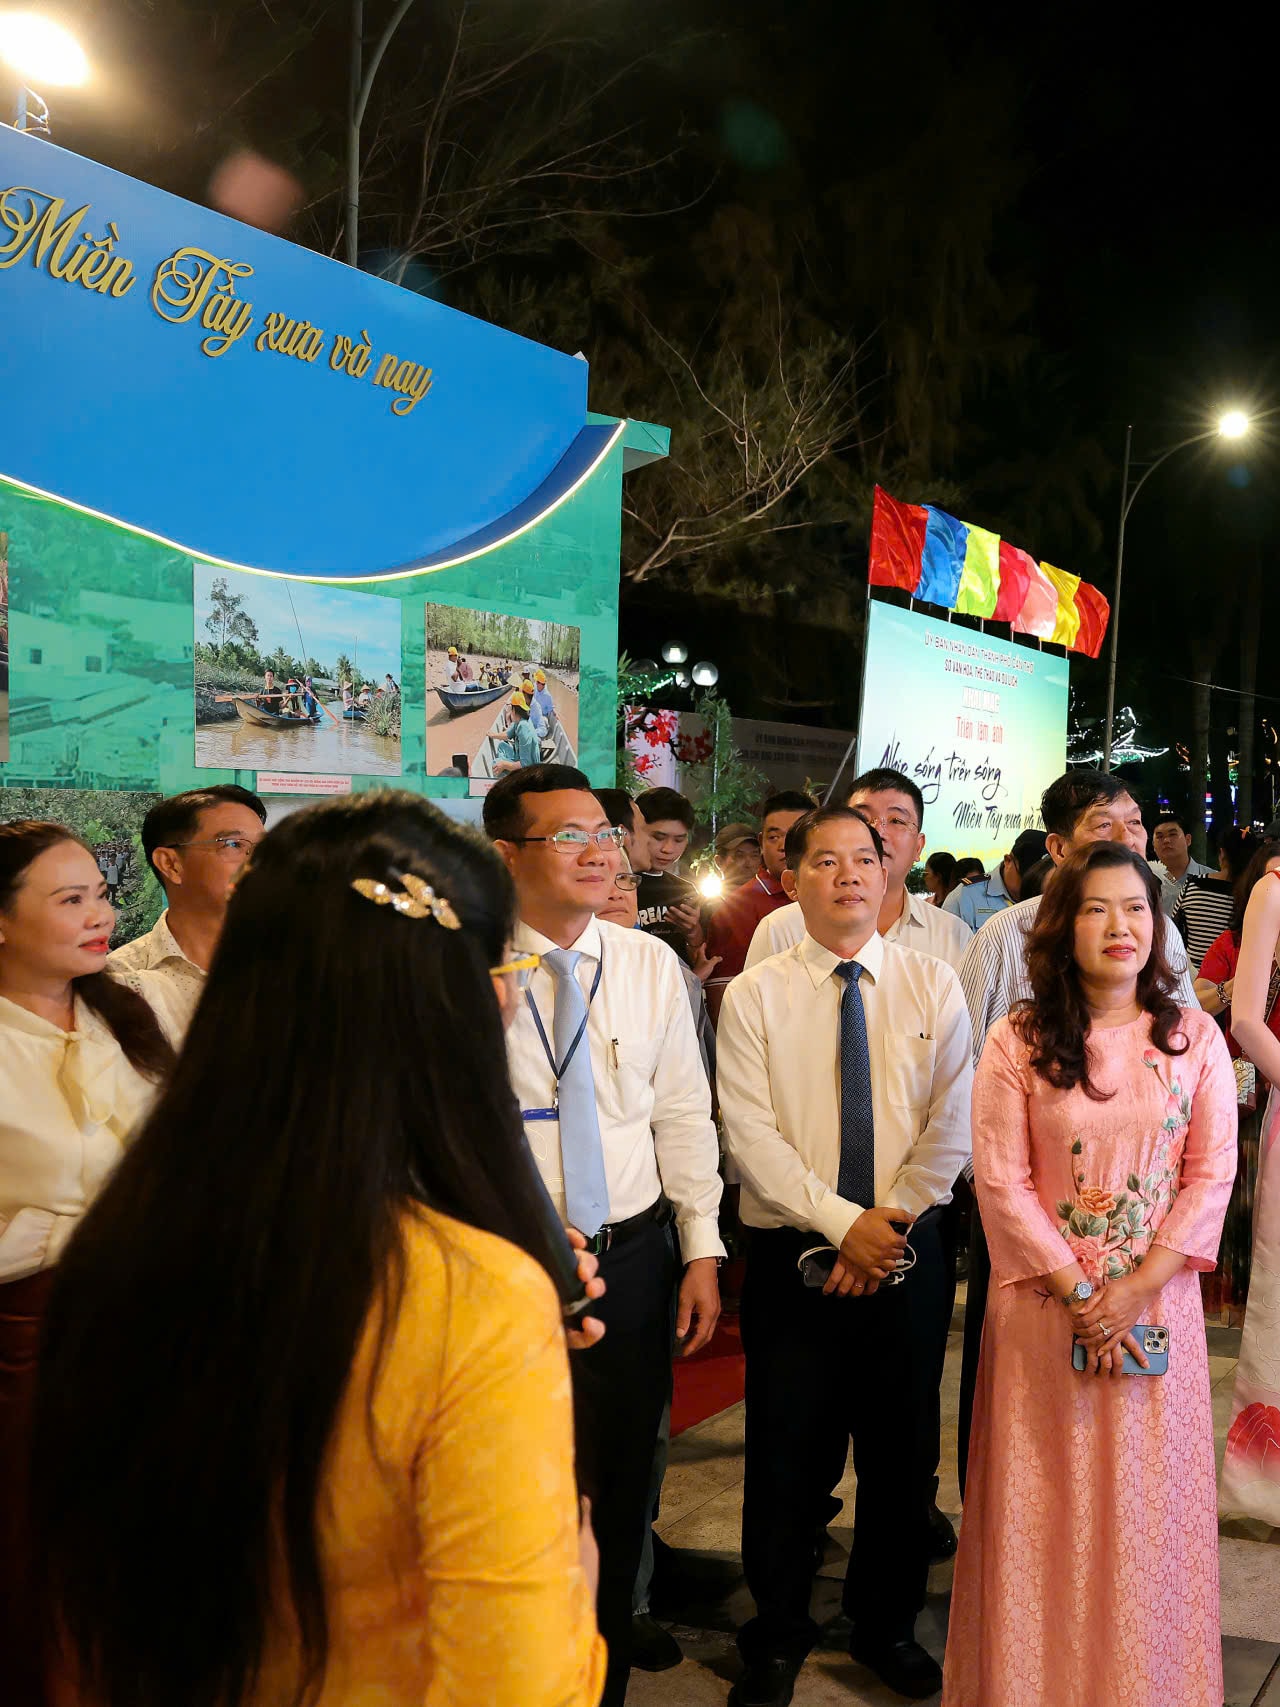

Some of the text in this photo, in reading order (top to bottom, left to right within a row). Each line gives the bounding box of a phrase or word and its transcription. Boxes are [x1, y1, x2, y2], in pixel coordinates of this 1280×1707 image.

[0, 186, 137, 298] Miền
[256, 311, 325, 362] xưa
[329, 329, 373, 379] và
[374, 351, 433, 416] nay
